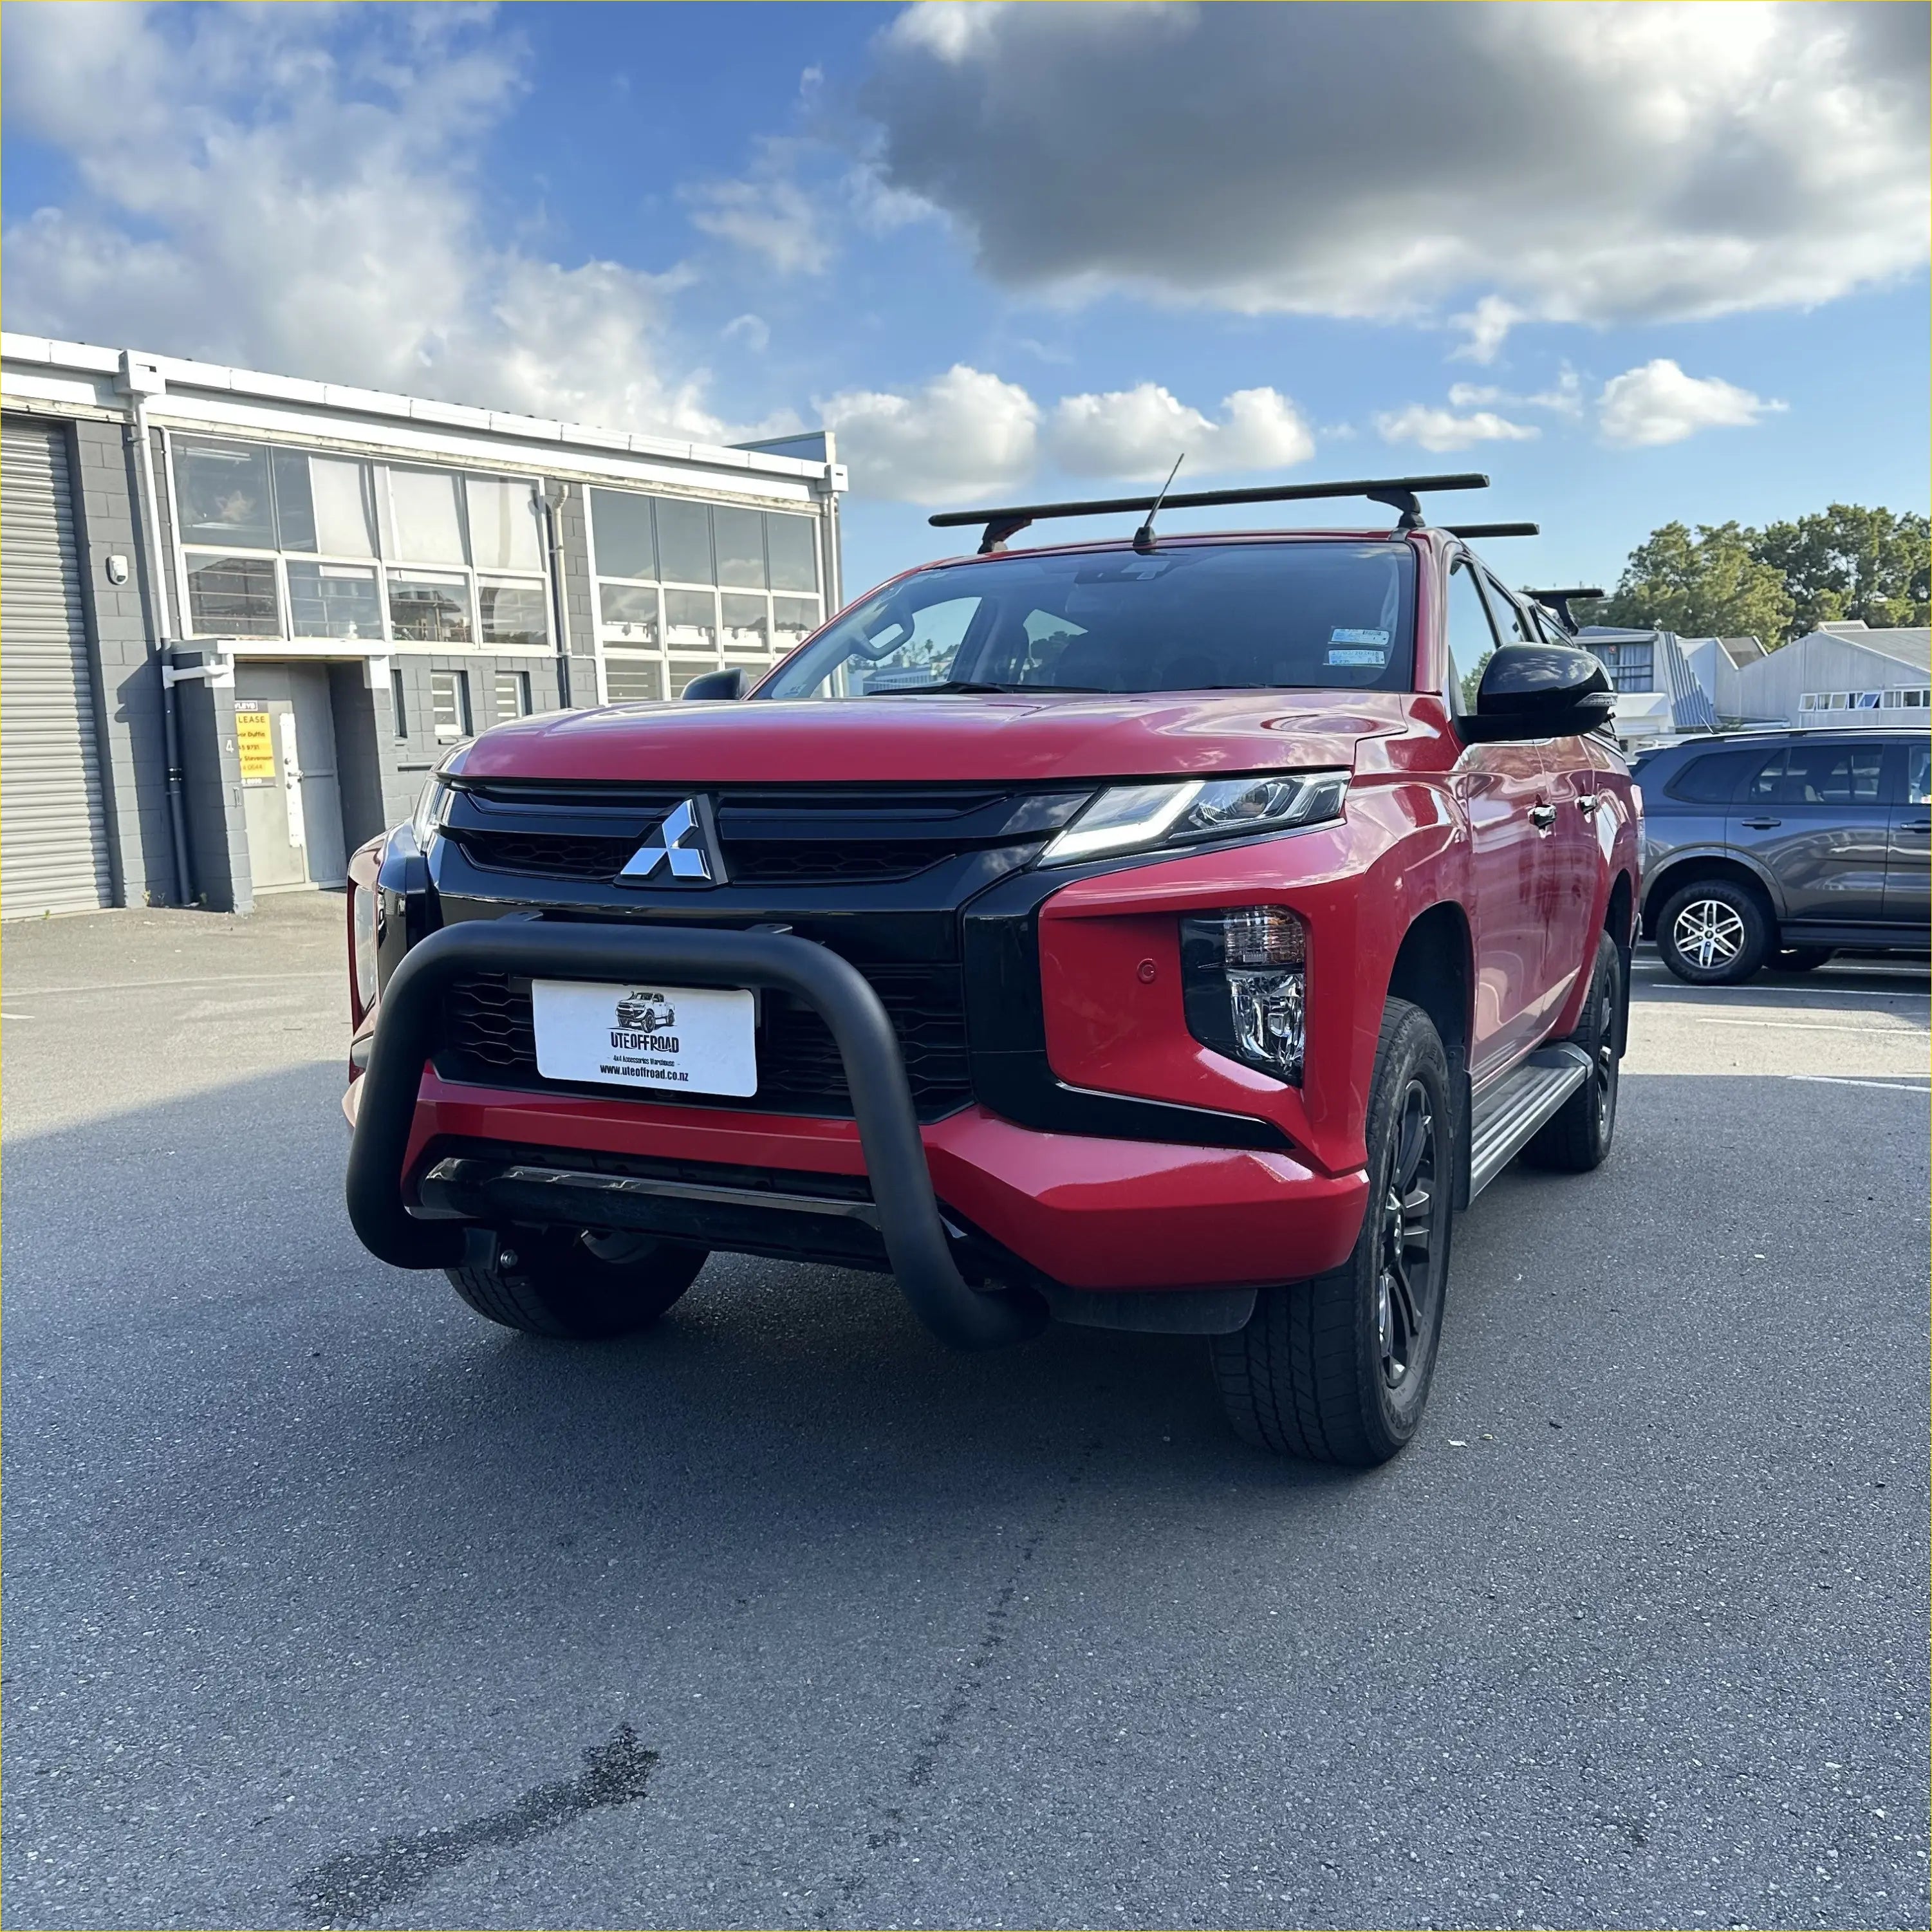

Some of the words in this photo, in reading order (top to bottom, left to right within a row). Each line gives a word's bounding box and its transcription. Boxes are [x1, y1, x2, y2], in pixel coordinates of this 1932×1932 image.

[225, 739, 234, 753] 4
[611, 1032, 679, 1053] UTEOFFROAD
[623, 1055, 649, 1064] Accessories
[600, 1064, 689, 1081] www.uteoffroad.co.nz
